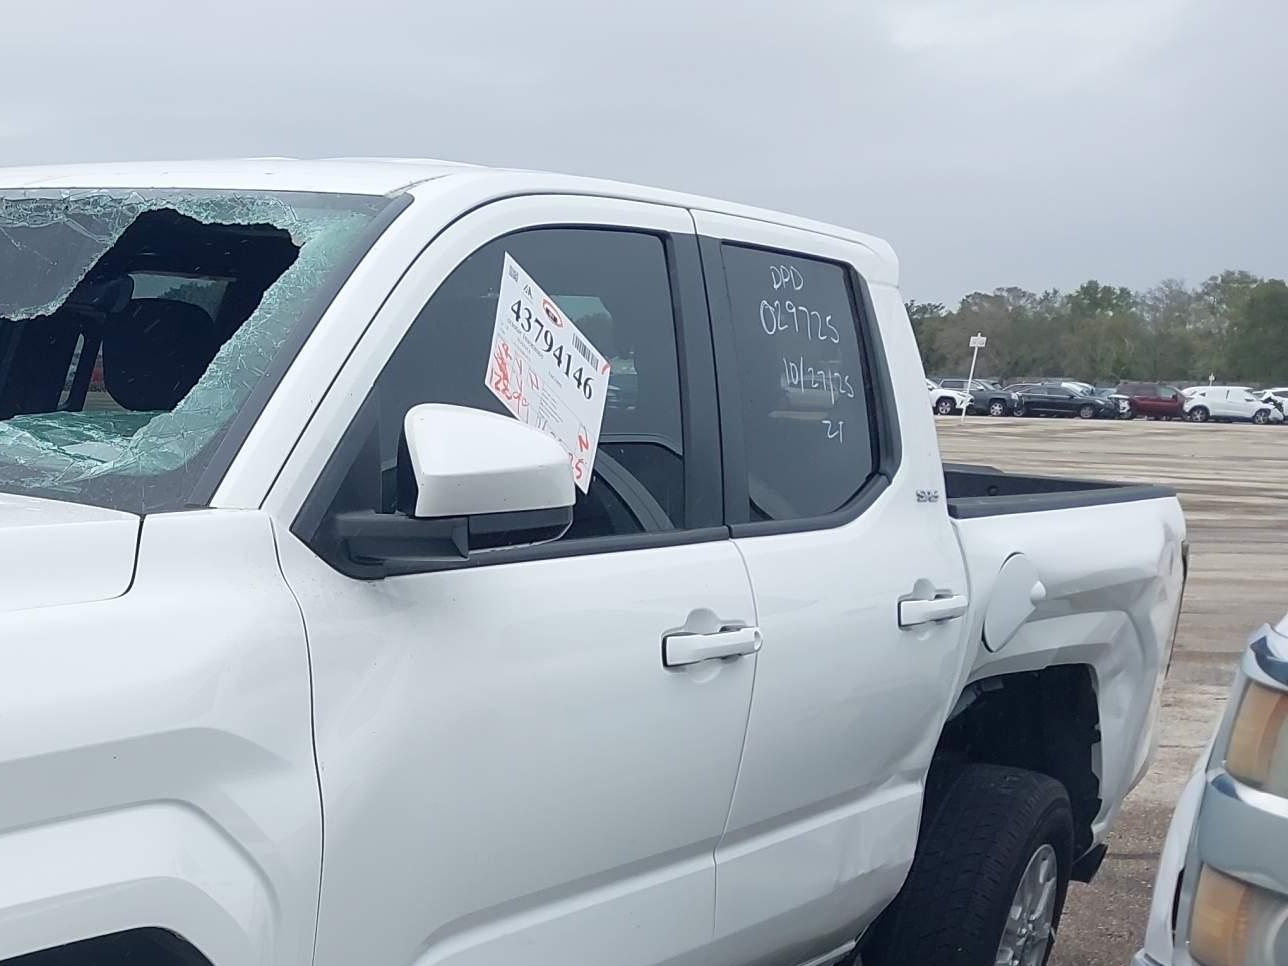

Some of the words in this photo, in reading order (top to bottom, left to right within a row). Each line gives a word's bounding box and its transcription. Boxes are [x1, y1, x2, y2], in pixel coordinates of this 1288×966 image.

[769, 264, 804, 291] DPD
[759, 299, 840, 344] 029725
[510, 299, 594, 400] 43794146
[783, 355, 855, 406] 10/27/25
